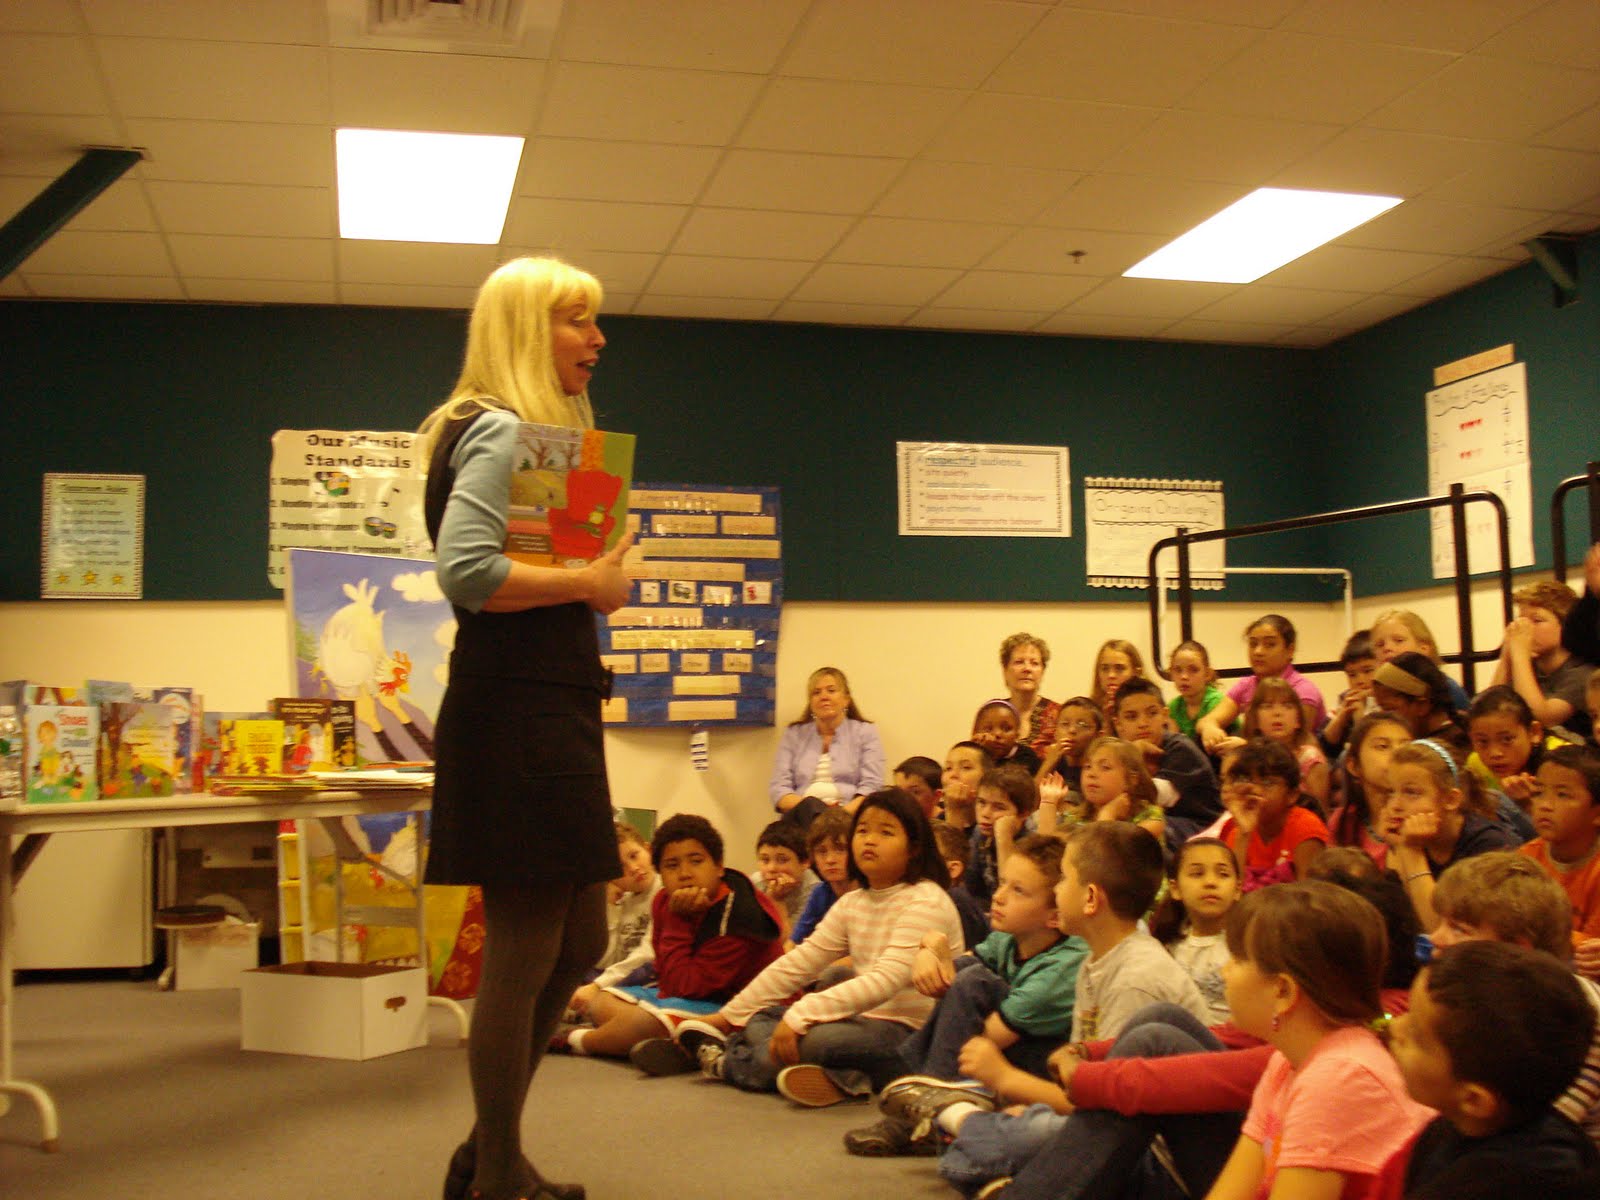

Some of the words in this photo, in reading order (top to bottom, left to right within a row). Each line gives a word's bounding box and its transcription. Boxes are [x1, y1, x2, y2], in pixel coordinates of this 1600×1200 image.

[306, 434, 345, 447] Our
[348, 434, 411, 449] Music
[305, 453, 411, 468] Standards
